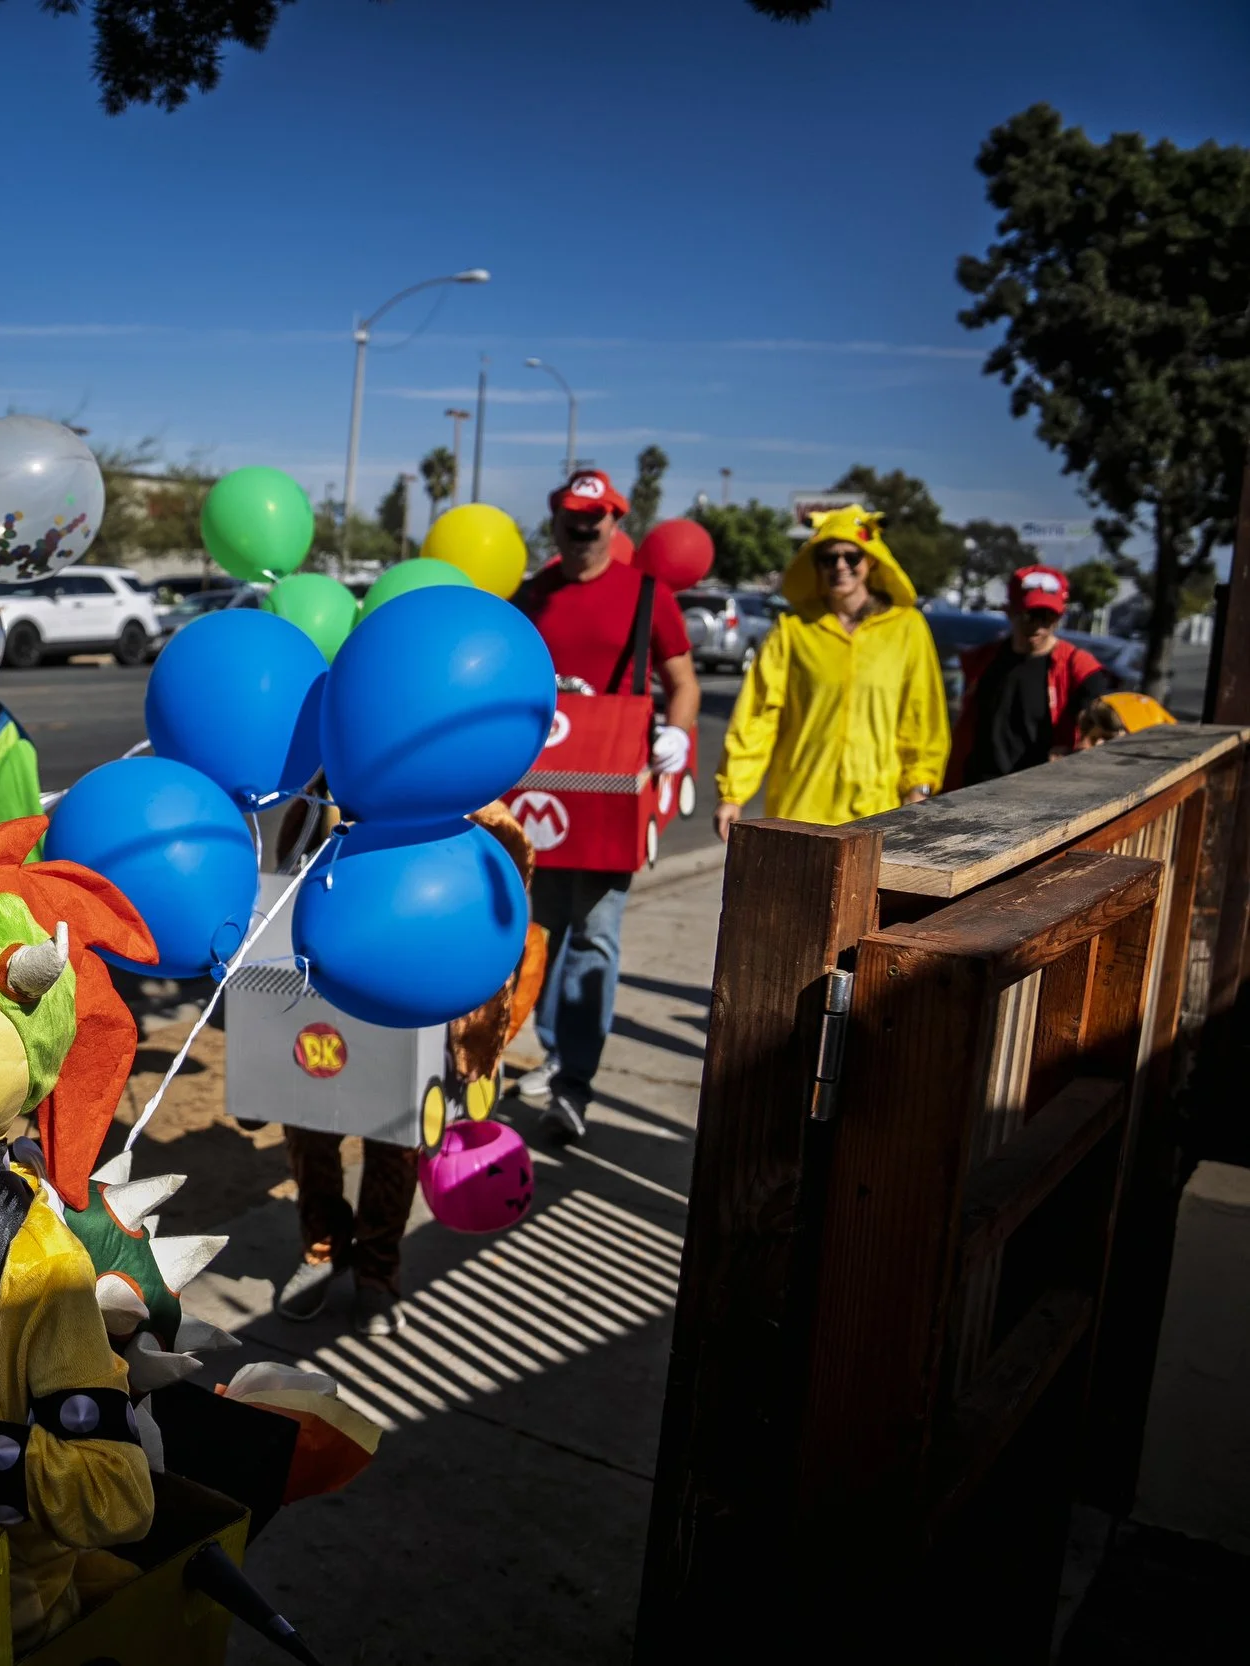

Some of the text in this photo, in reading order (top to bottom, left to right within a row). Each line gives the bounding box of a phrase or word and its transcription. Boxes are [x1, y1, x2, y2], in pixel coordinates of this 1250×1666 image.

[576, 477, 598, 493] M
[515, 799, 566, 838] M
[301, 1032, 343, 1070] DK
